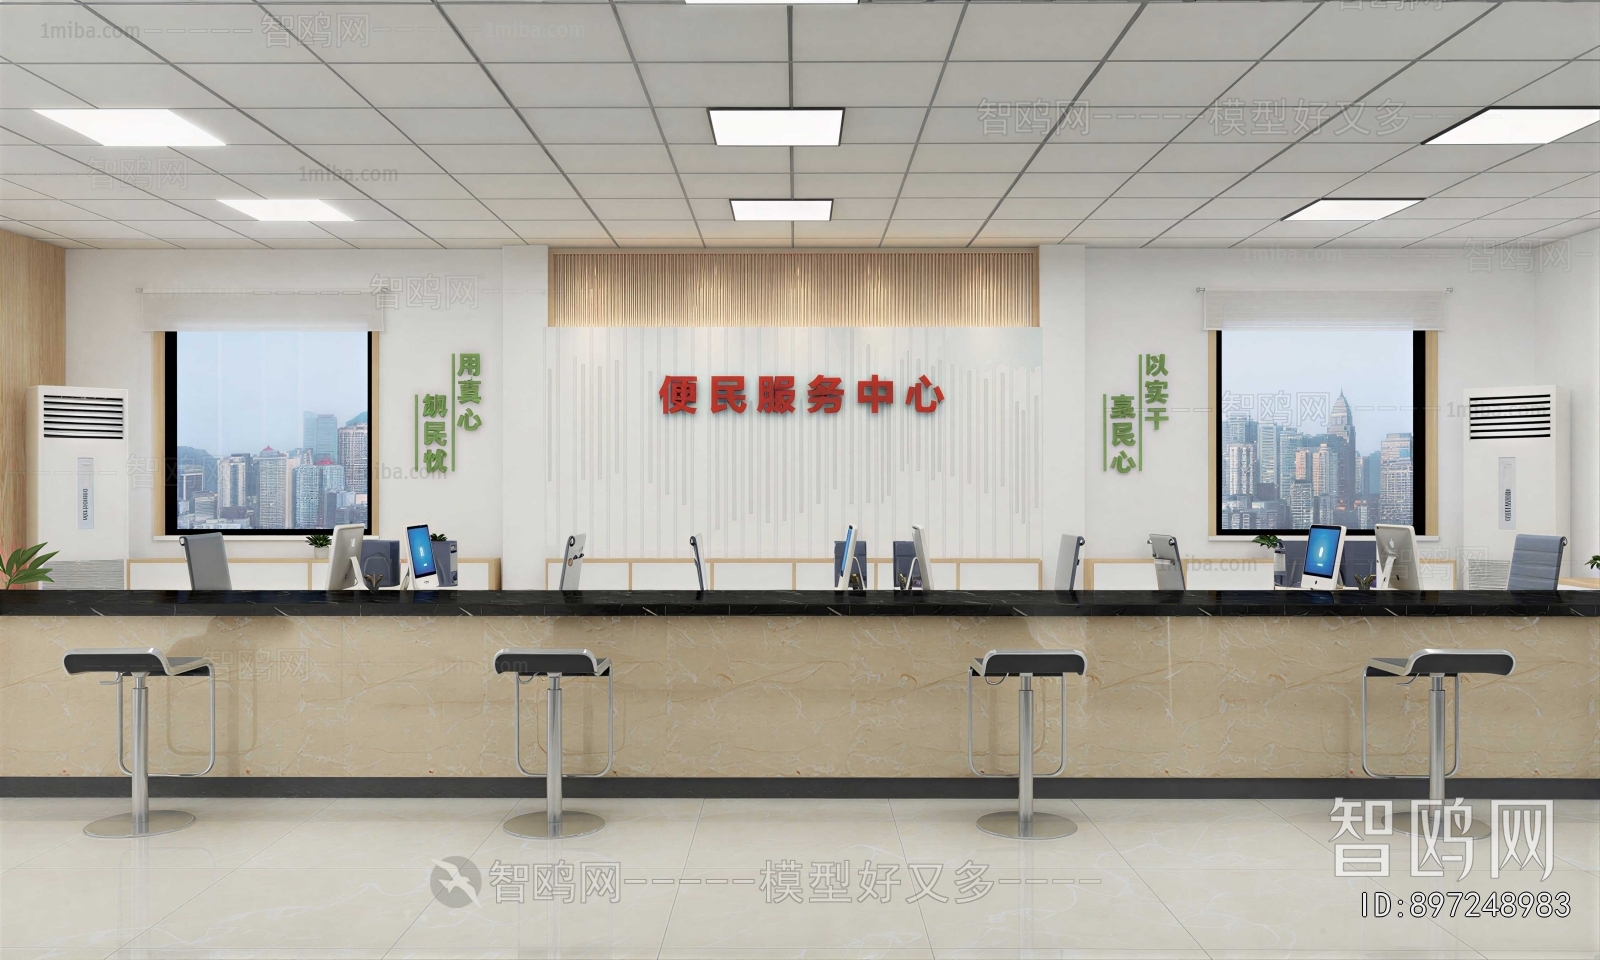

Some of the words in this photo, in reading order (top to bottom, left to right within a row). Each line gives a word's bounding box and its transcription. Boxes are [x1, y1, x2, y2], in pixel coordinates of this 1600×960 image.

[457, 353, 482, 431] 用真心
[659, 374, 945, 414] 便民服务中心
[1144, 353, 1169, 430] 以实干
